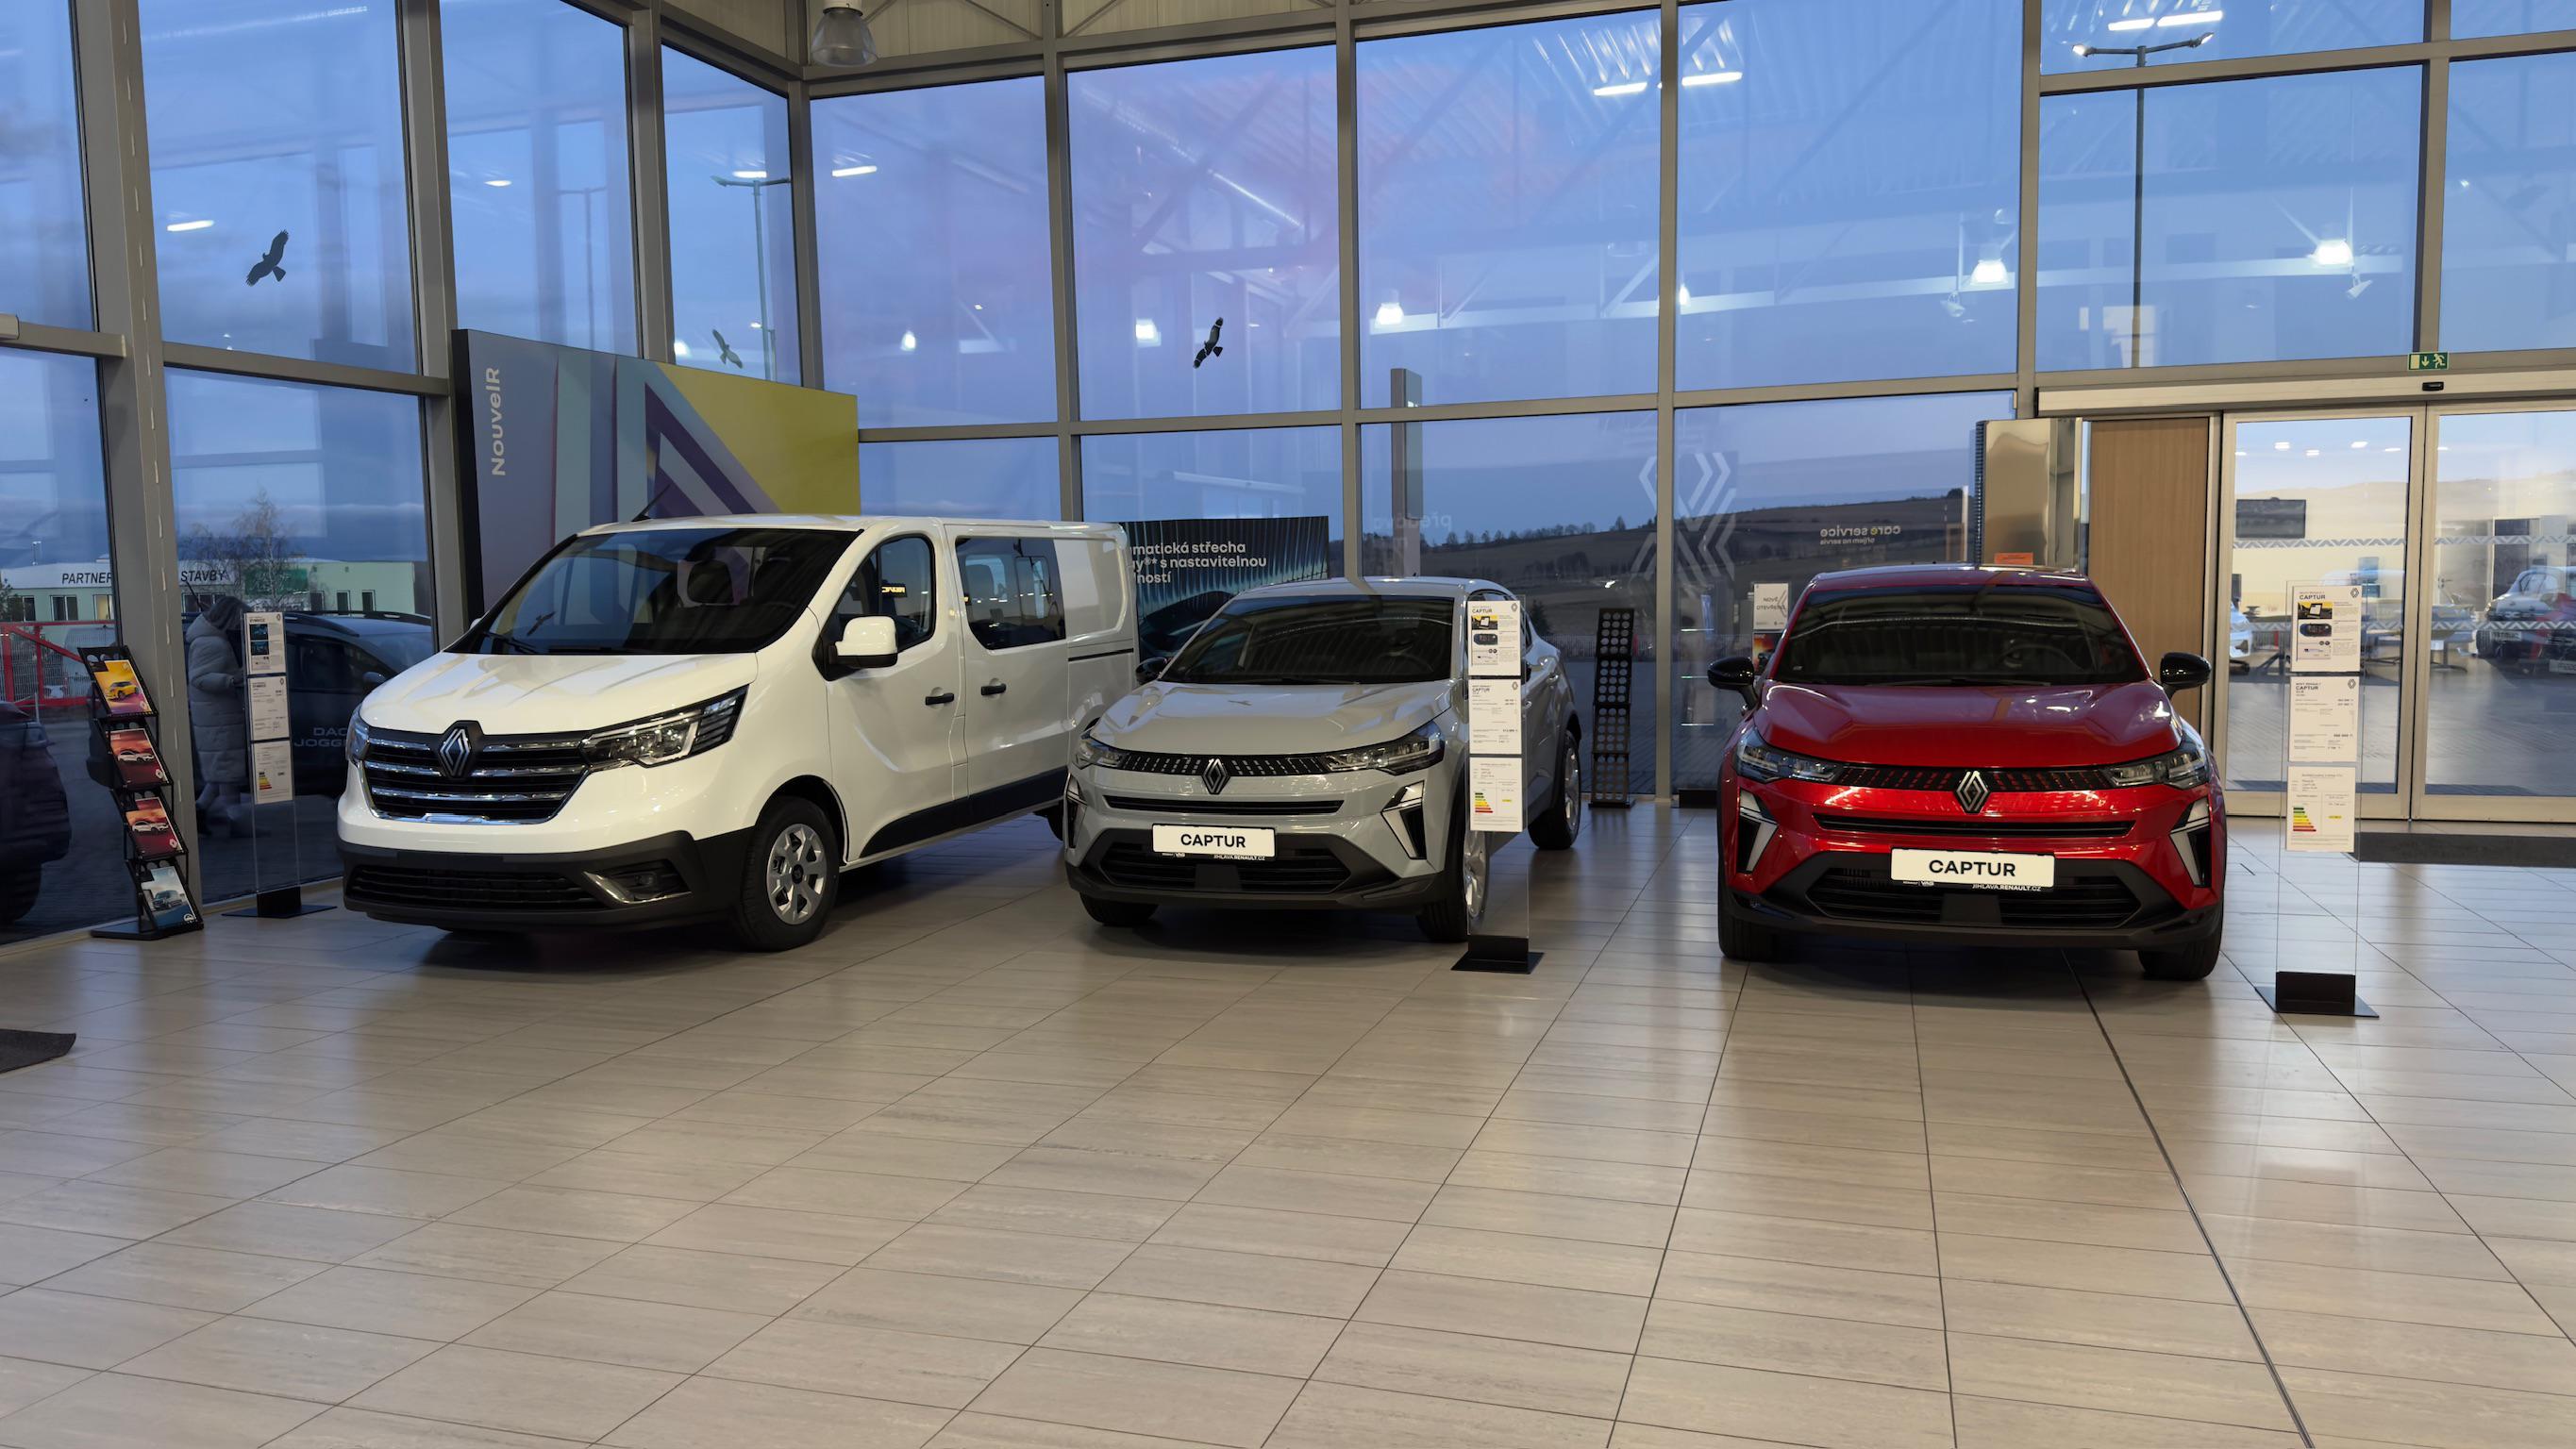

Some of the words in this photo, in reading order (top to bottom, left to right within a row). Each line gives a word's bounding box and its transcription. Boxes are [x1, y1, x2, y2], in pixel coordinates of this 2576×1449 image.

[485, 367, 506, 476] NouvelR
[1130, 541, 1189, 555] matická
[1192, 541, 1246, 554] střecha
[1160, 559, 1168, 569] s
[1170, 556, 1267, 568] nastavitelnou
[180, 570, 226, 582] STAVBY
[1134, 571, 1171, 584] ností
[294, 739, 346, 747] JOGG
[1180, 833, 1246, 848] CAPTUR
[1929, 859, 2016, 877] CAPTUR
